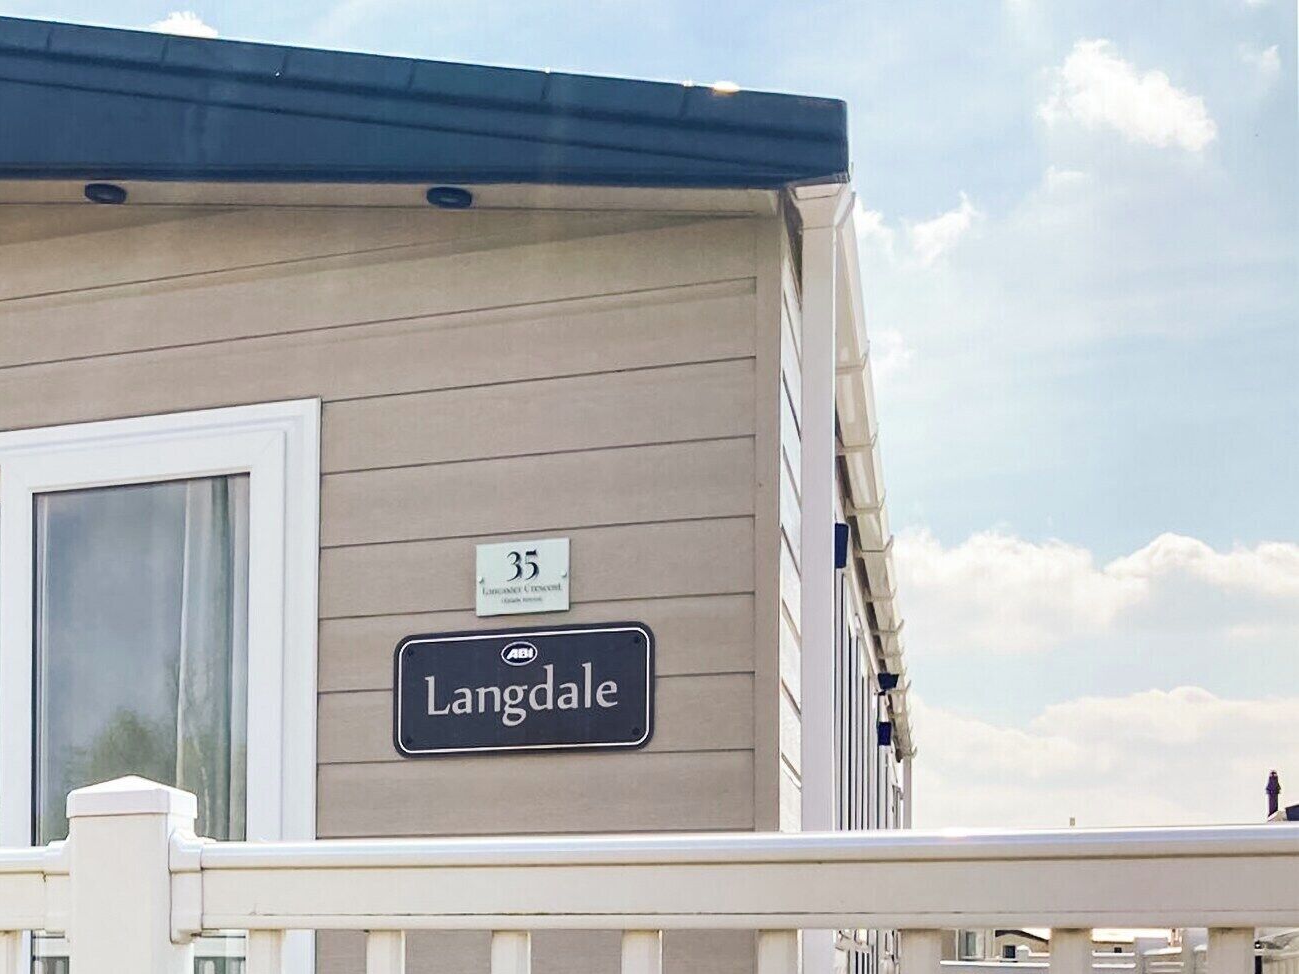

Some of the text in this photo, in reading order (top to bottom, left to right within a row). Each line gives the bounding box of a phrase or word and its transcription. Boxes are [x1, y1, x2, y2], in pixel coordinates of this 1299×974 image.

[506, 549, 540, 582] 35
[523, 584, 562, 594] Crescent
[506, 647, 534, 660] ABI
[424, 662, 619, 727] Langdale
